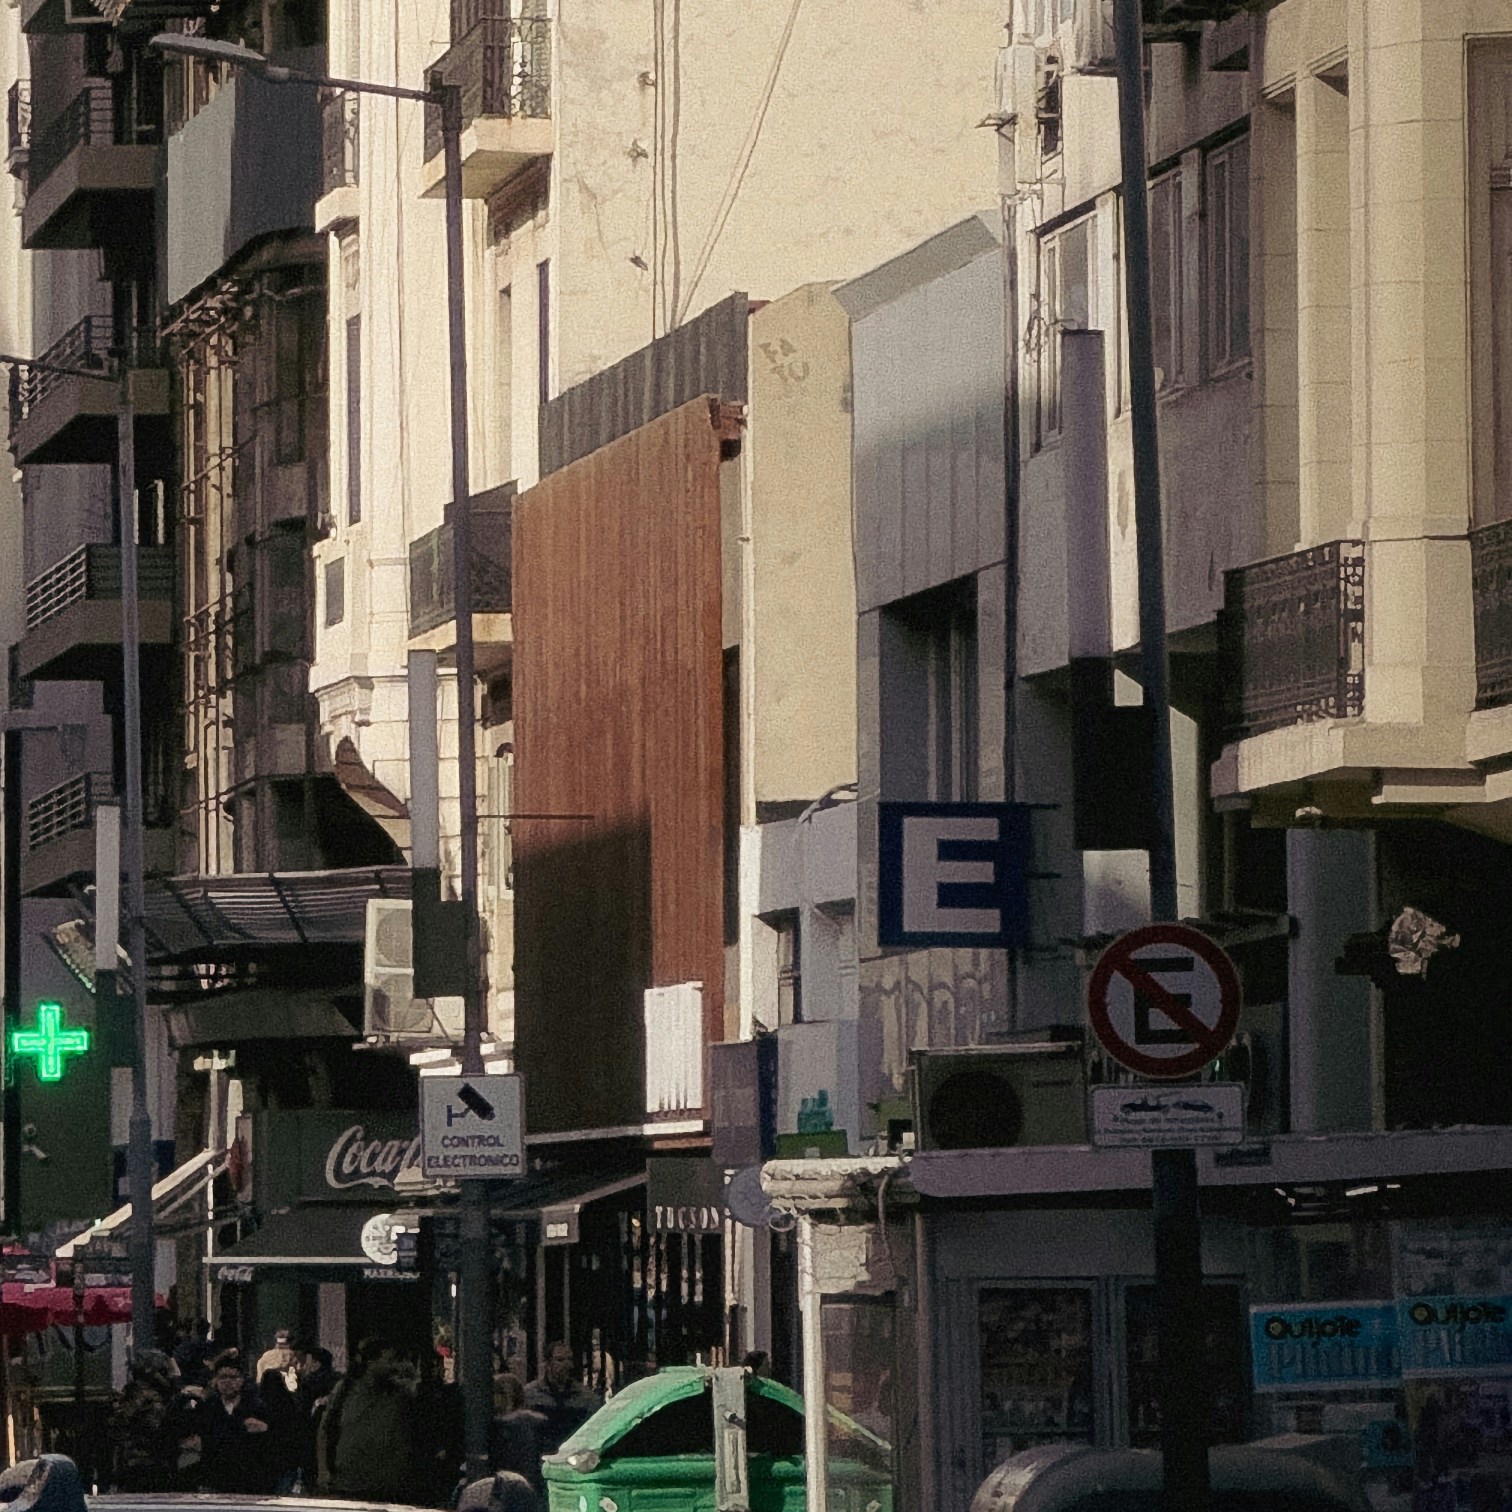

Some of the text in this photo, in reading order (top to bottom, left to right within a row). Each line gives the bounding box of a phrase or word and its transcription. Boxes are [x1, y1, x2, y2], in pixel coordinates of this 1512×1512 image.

[902, 816, 1002, 933] E
[1134, 956, 1199, 1045] E
[440, 1134, 505, 1148] CONTROL
